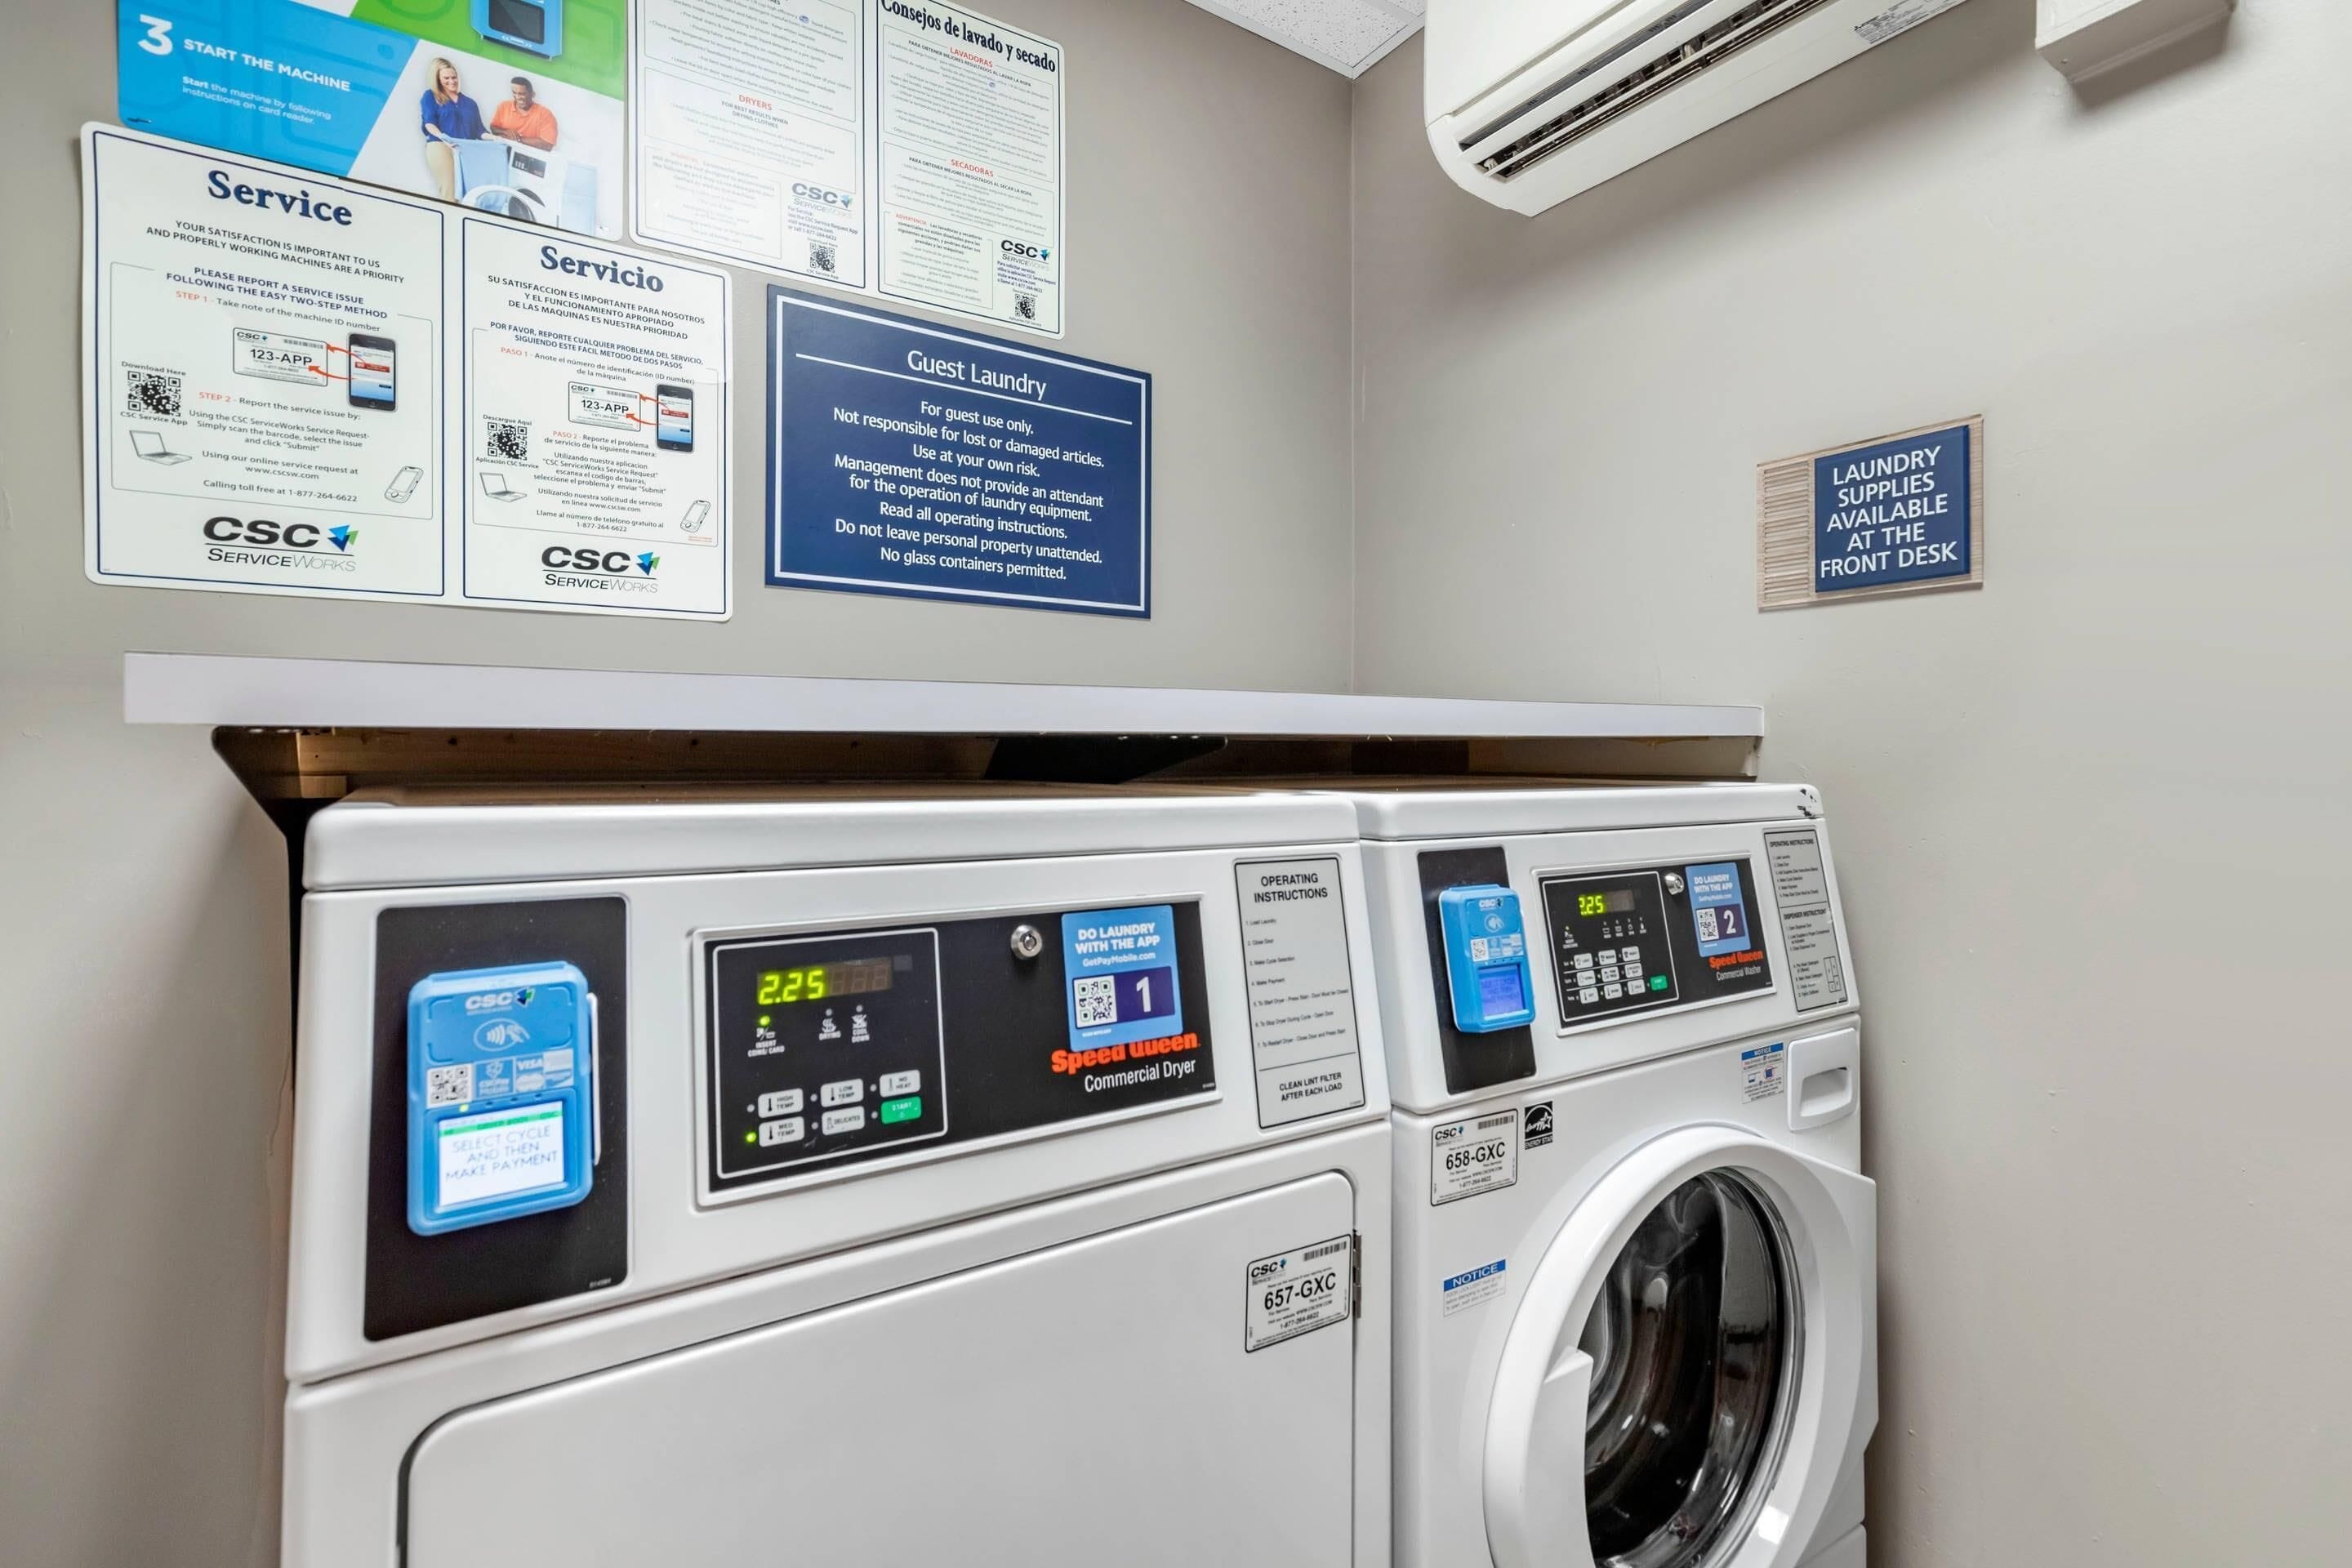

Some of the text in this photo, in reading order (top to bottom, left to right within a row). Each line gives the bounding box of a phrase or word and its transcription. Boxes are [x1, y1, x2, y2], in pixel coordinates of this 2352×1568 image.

[137, 15, 173, 56] 3
[881, 0, 1056, 72] Consejos de lavado y secado
[184, 38, 350, 91] START THE MACHINE
[950, 47, 993, 68] LAVADORAS
[182, 76, 332, 120] Start the machine by following
[182, 86, 314, 123] instructions on card reader.
[738, 94, 773, 111] DRYERS
[951, 158, 994, 177] SECADORAS
[208, 170, 352, 226] Service
[791, 182, 839, 204] CSC
[176, 220, 380, 268] YOUR SATISFACTION IS IMPORTANT TO US
[1001, 239, 1038, 259] CSC
[541, 246, 663, 292] Servicio
[176, 291, 200, 300] STEP
[216, 297, 239, 308] Take
[241, 303, 263, 312] note
[277, 308, 292, 317] the
[294, 312, 332, 323] machine
[334, 318, 345, 326] ID
[345, 321, 380, 332] number
[488, 274, 705, 324] SU SATISFACCION ES IMPORTANTE PARA NOSOTROS
[250, 349, 313, 367] 123-APP
[907, 350, 1046, 400] Guest Laundry
[920, 400, 1034, 436] For guest use only.
[833, 407, 1104, 467] Not responsible for lost or damaged articles.
[245, 466, 319, 480] www.cscsw.com
[913, 443, 1040, 477] Use at your own risk.
[1833, 446, 1941, 485] LAUNDRY
[203, 479, 236, 491] Calling
[256, 485, 274, 493] free
[288, 489, 357, 502] 1-877-264-6622
[834, 453, 1103, 507] Management does not provide an attendant
[1838, 472, 1935, 507] SUPPLIES
[849, 474, 1092, 522] for the operation of laundry equipment.
[880, 501, 1067, 539] Read all operating instructions.
[1827, 494, 1948, 532] AVAILABLE
[203, 515, 320, 549] CSC
[835, 518, 1102, 564] Do not leave personal property unattended.
[1847, 523, 1925, 552] AT THE
[541, 546, 630, 573] CSC
[880, 546, 1067, 580] No glass containers permitted.
[1821, 541, 1958, 578] FRONT DESK
[1261, 873, 1318, 886] OPERATING
[1254, 888, 1328, 902] INSTRUCTIONS
[1078, 923, 1156, 940] DO LAUNDRY
[1723, 910, 1736, 933] 2
[1075, 935, 1160, 954] WITH THE APP
[1083, 951, 1156, 967] GetPayMobile.com
[1709, 950, 1764, 969] Speed Queen
[1717, 965, 1762, 981] Commercial Washer
[759, 969, 824, 1004] 2.25
[1136, 977, 1151, 1013] 1
[466, 995, 513, 1009] CSC
[517, 1058, 542, 1070] VISA
[1051, 1032, 1198, 1075] Speed Queen
[1085, 1059, 1196, 1093] Commercial Dryer
[1280, 1071, 1342, 1092] CLEAN LINT FILTER
[1281, 1082, 1343, 1102] AFTER EACH LOAD
[834, 1115, 860, 1125] DELICATES
[892, 1102, 911, 1111] START
[452, 1126, 551, 1153] SELECT CYCLE
[1435, 1128, 1457, 1140] CSC
[1526, 1138, 1541, 1149] ENERGY
[446, 1151, 559, 1179] MAKE PAYMENT
[466, 1143, 539, 1163] AND THEN
[1446, 1143, 1505, 1169] 658-GXC
[1251, 1262, 1278, 1278] CSC
[1453, 1264, 1498, 1287] NOTICE
[1264, 1272, 1336, 1310] 657-GXC
